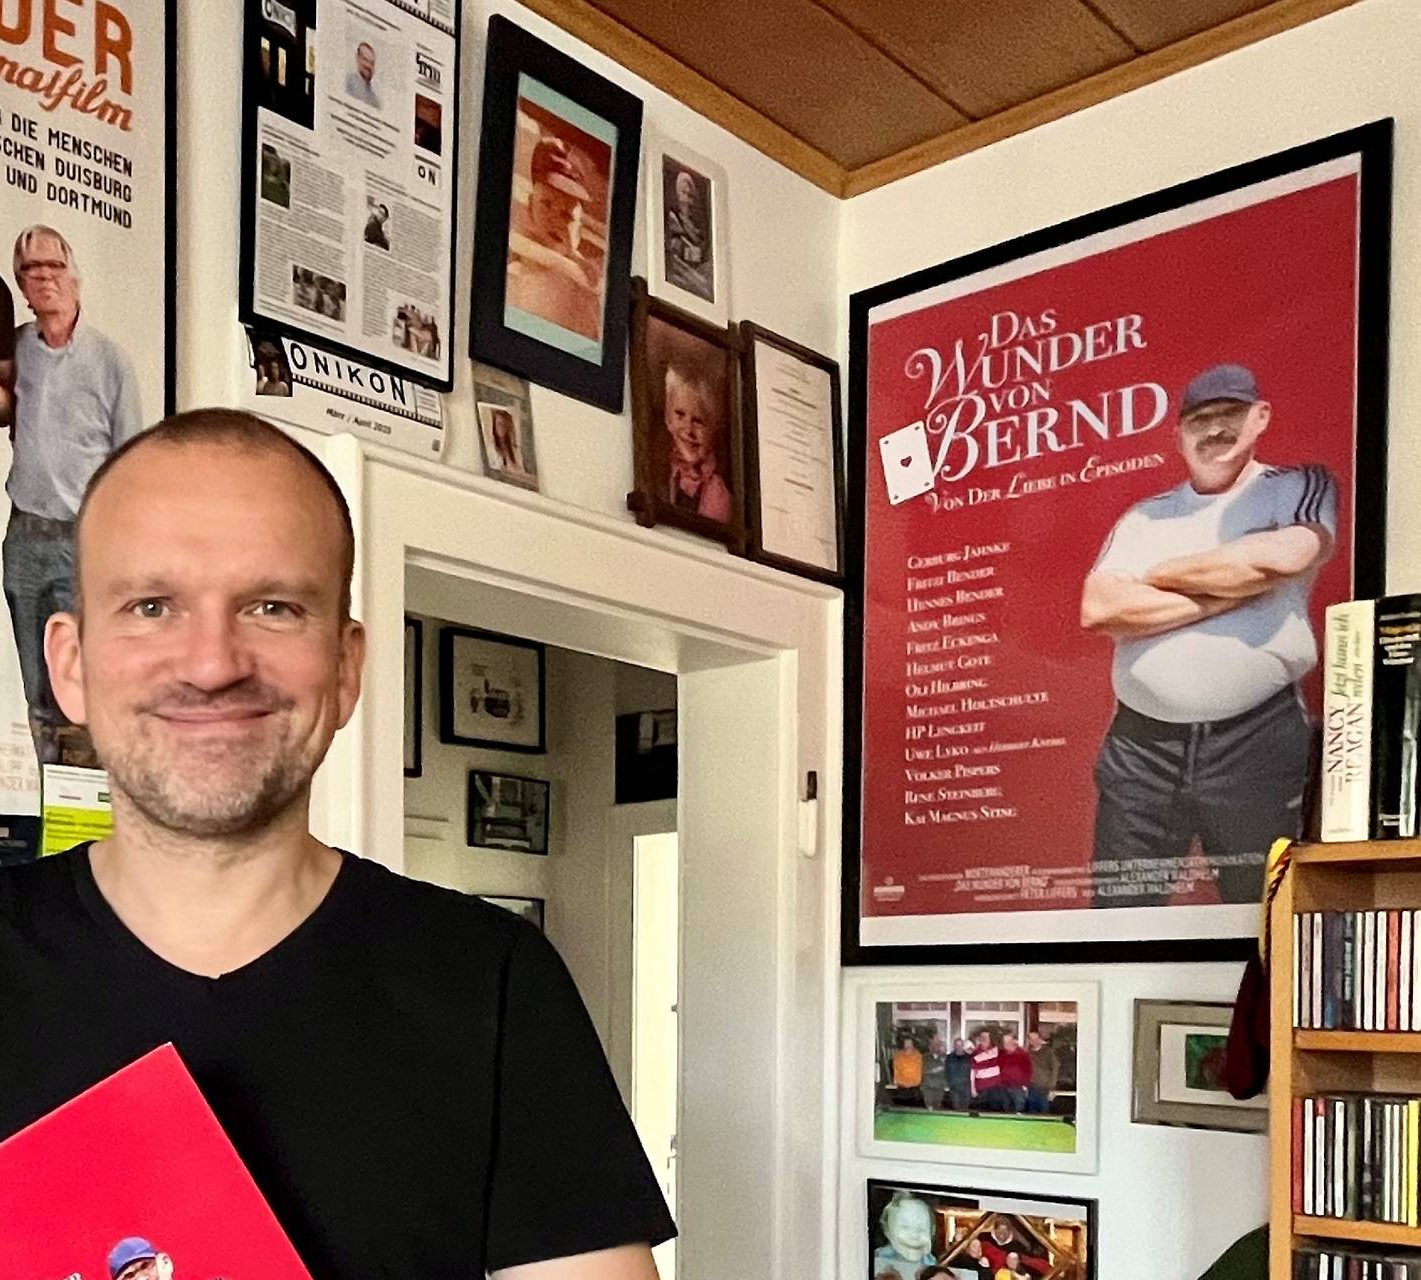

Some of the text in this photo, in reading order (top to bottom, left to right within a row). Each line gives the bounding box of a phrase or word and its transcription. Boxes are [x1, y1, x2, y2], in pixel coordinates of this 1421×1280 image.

[11, 113, 38, 140] DIE
[48, 128, 132, 177] MENSCHEN
[6, 166, 132, 229] UND DORTMUND
[55, 158, 132, 202] DUISBURG
[926, 382, 1169, 482] BERND
[1327, 704, 1345, 774] NANCY
[1345, 702, 1364, 784] REAGAN
